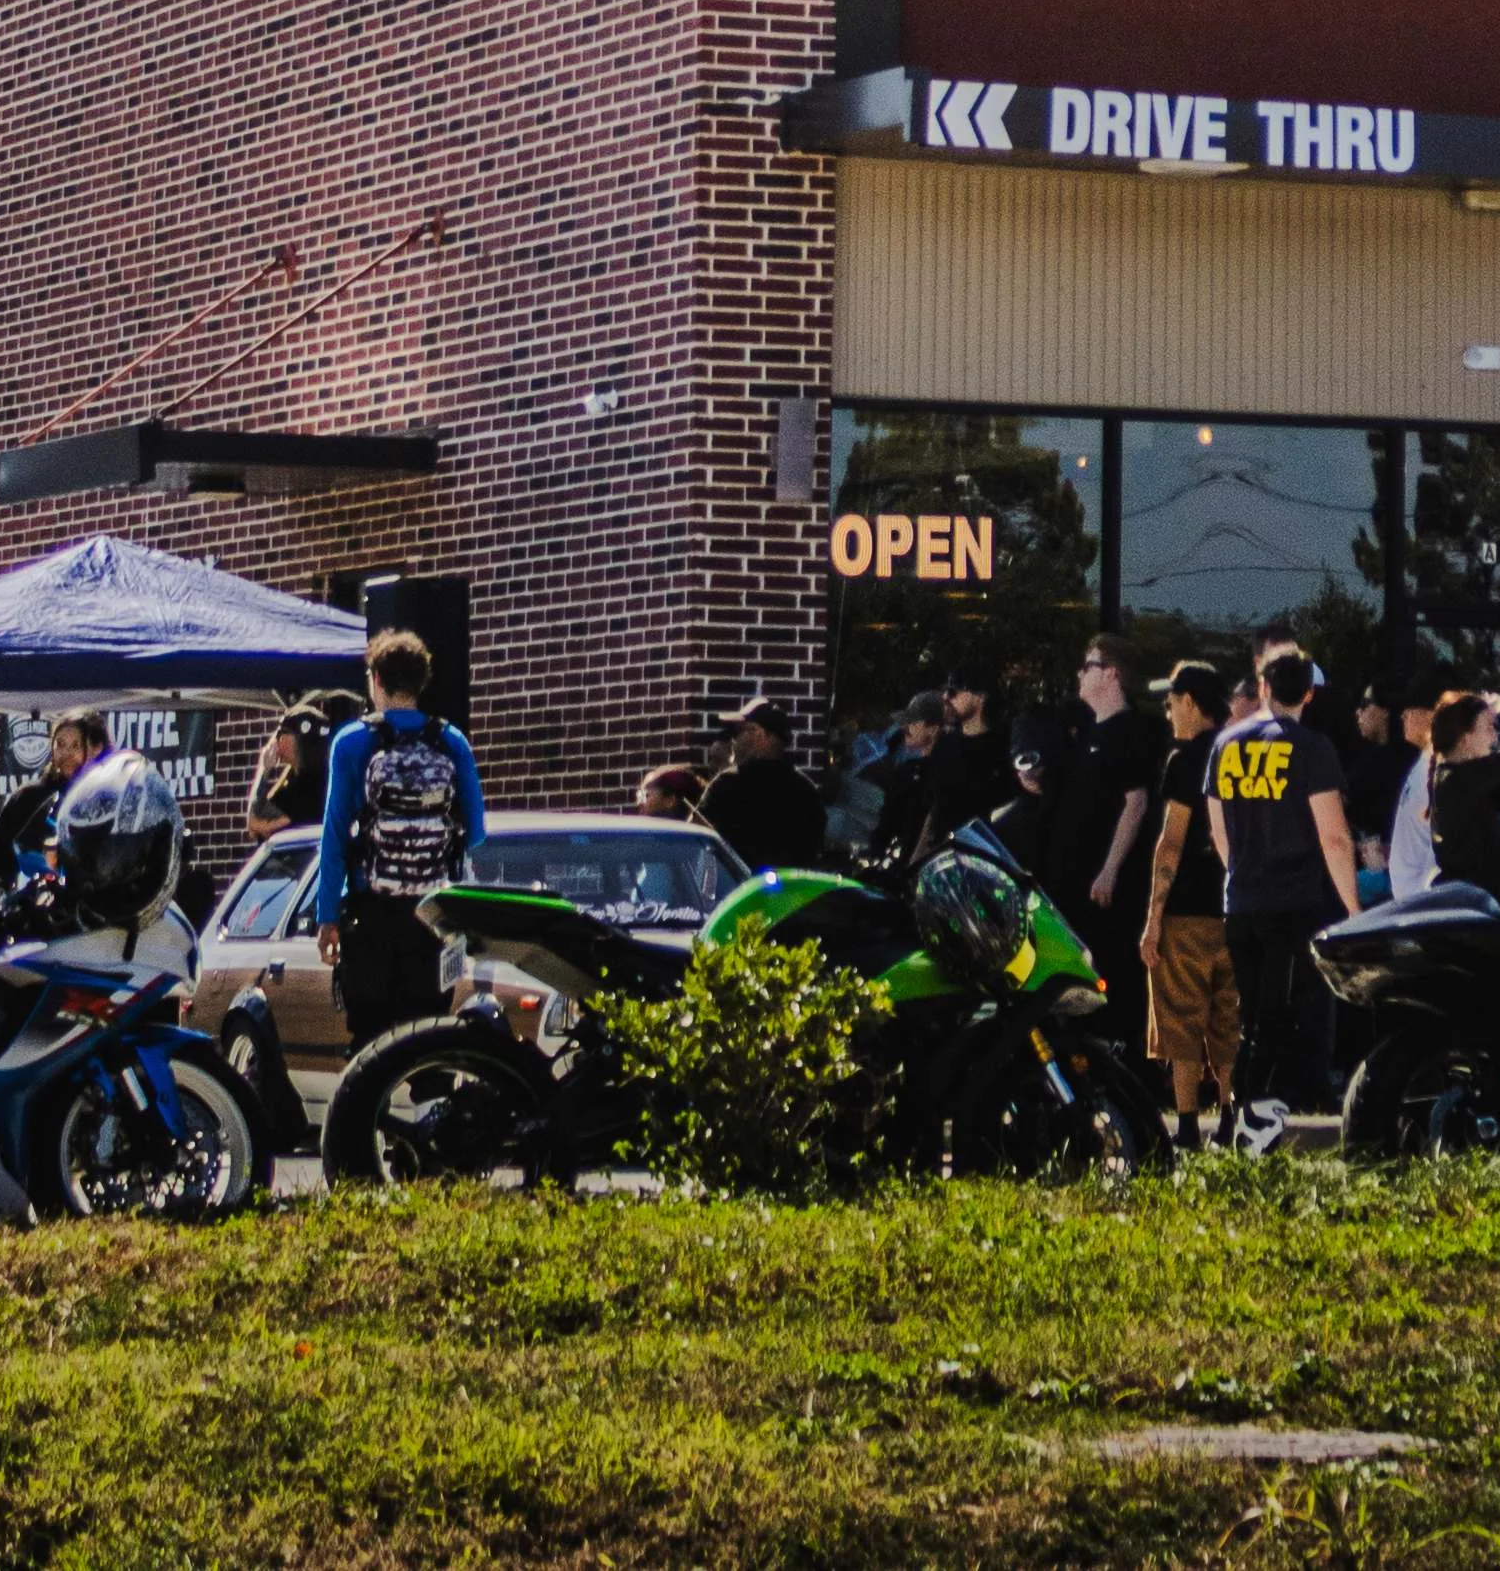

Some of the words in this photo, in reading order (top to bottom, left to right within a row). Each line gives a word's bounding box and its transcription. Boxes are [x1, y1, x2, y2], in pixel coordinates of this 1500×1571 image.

[1050, 87, 1228, 164] DRIVE
[1257, 100, 1415, 173] THRU
[830, 514, 993, 580] OPEN
[1217, 739, 1293, 778] ATF
[1238, 775, 1289, 801] GAY
